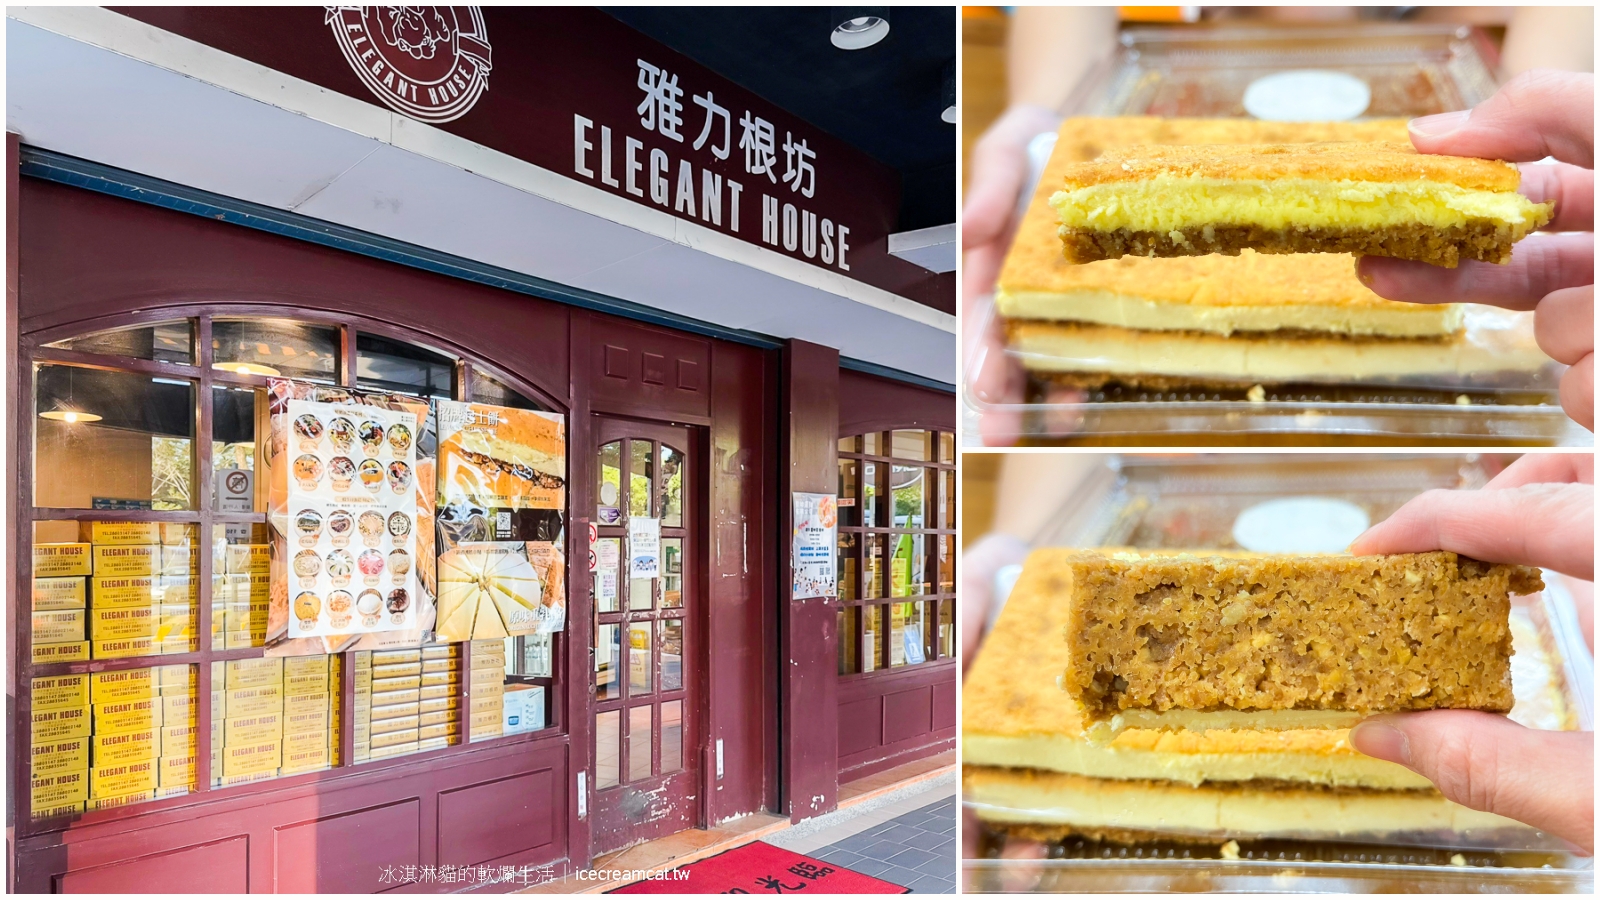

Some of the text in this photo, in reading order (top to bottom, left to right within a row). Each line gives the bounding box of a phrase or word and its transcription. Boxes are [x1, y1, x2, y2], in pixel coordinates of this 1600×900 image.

[346, 24, 472, 105] ELEGANT HOUSE
[637, 58, 817, 199] 雅力根坊
[574, 112, 850, 272] ELEGANT HOUSE
[34, 546, 83, 556] EGANT HOUSE
[102, 548, 130, 557] ELEGANT
[101, 579, 129, 588] ELEGANT
[101, 611, 129, 620] ELEGANT
[33, 645, 82, 657] EGANT HOUSE
[102, 642, 130, 652] ELEGANT
[33, 677, 81, 690] EGANT HOUSE
[100, 673, 128, 683] ELEGANT
[104, 703, 131, 714] ELEGANT
[32, 709, 83, 722] LEGANT HOUSE
[233, 716, 277, 728] ELEGANT HOUSE
[102, 731, 153, 746] ELEGANT HOUSE
[32, 741, 80, 756] EGANT HOUSE
[232, 744, 275, 757] ELEGANT HOUSE
[170, 757, 195, 767] ELEGANT
[99, 762, 151, 778] ELEGANT HOUSE
[32, 774, 80, 788] EGANT HOUSE
[32, 809, 50, 818] GANT
